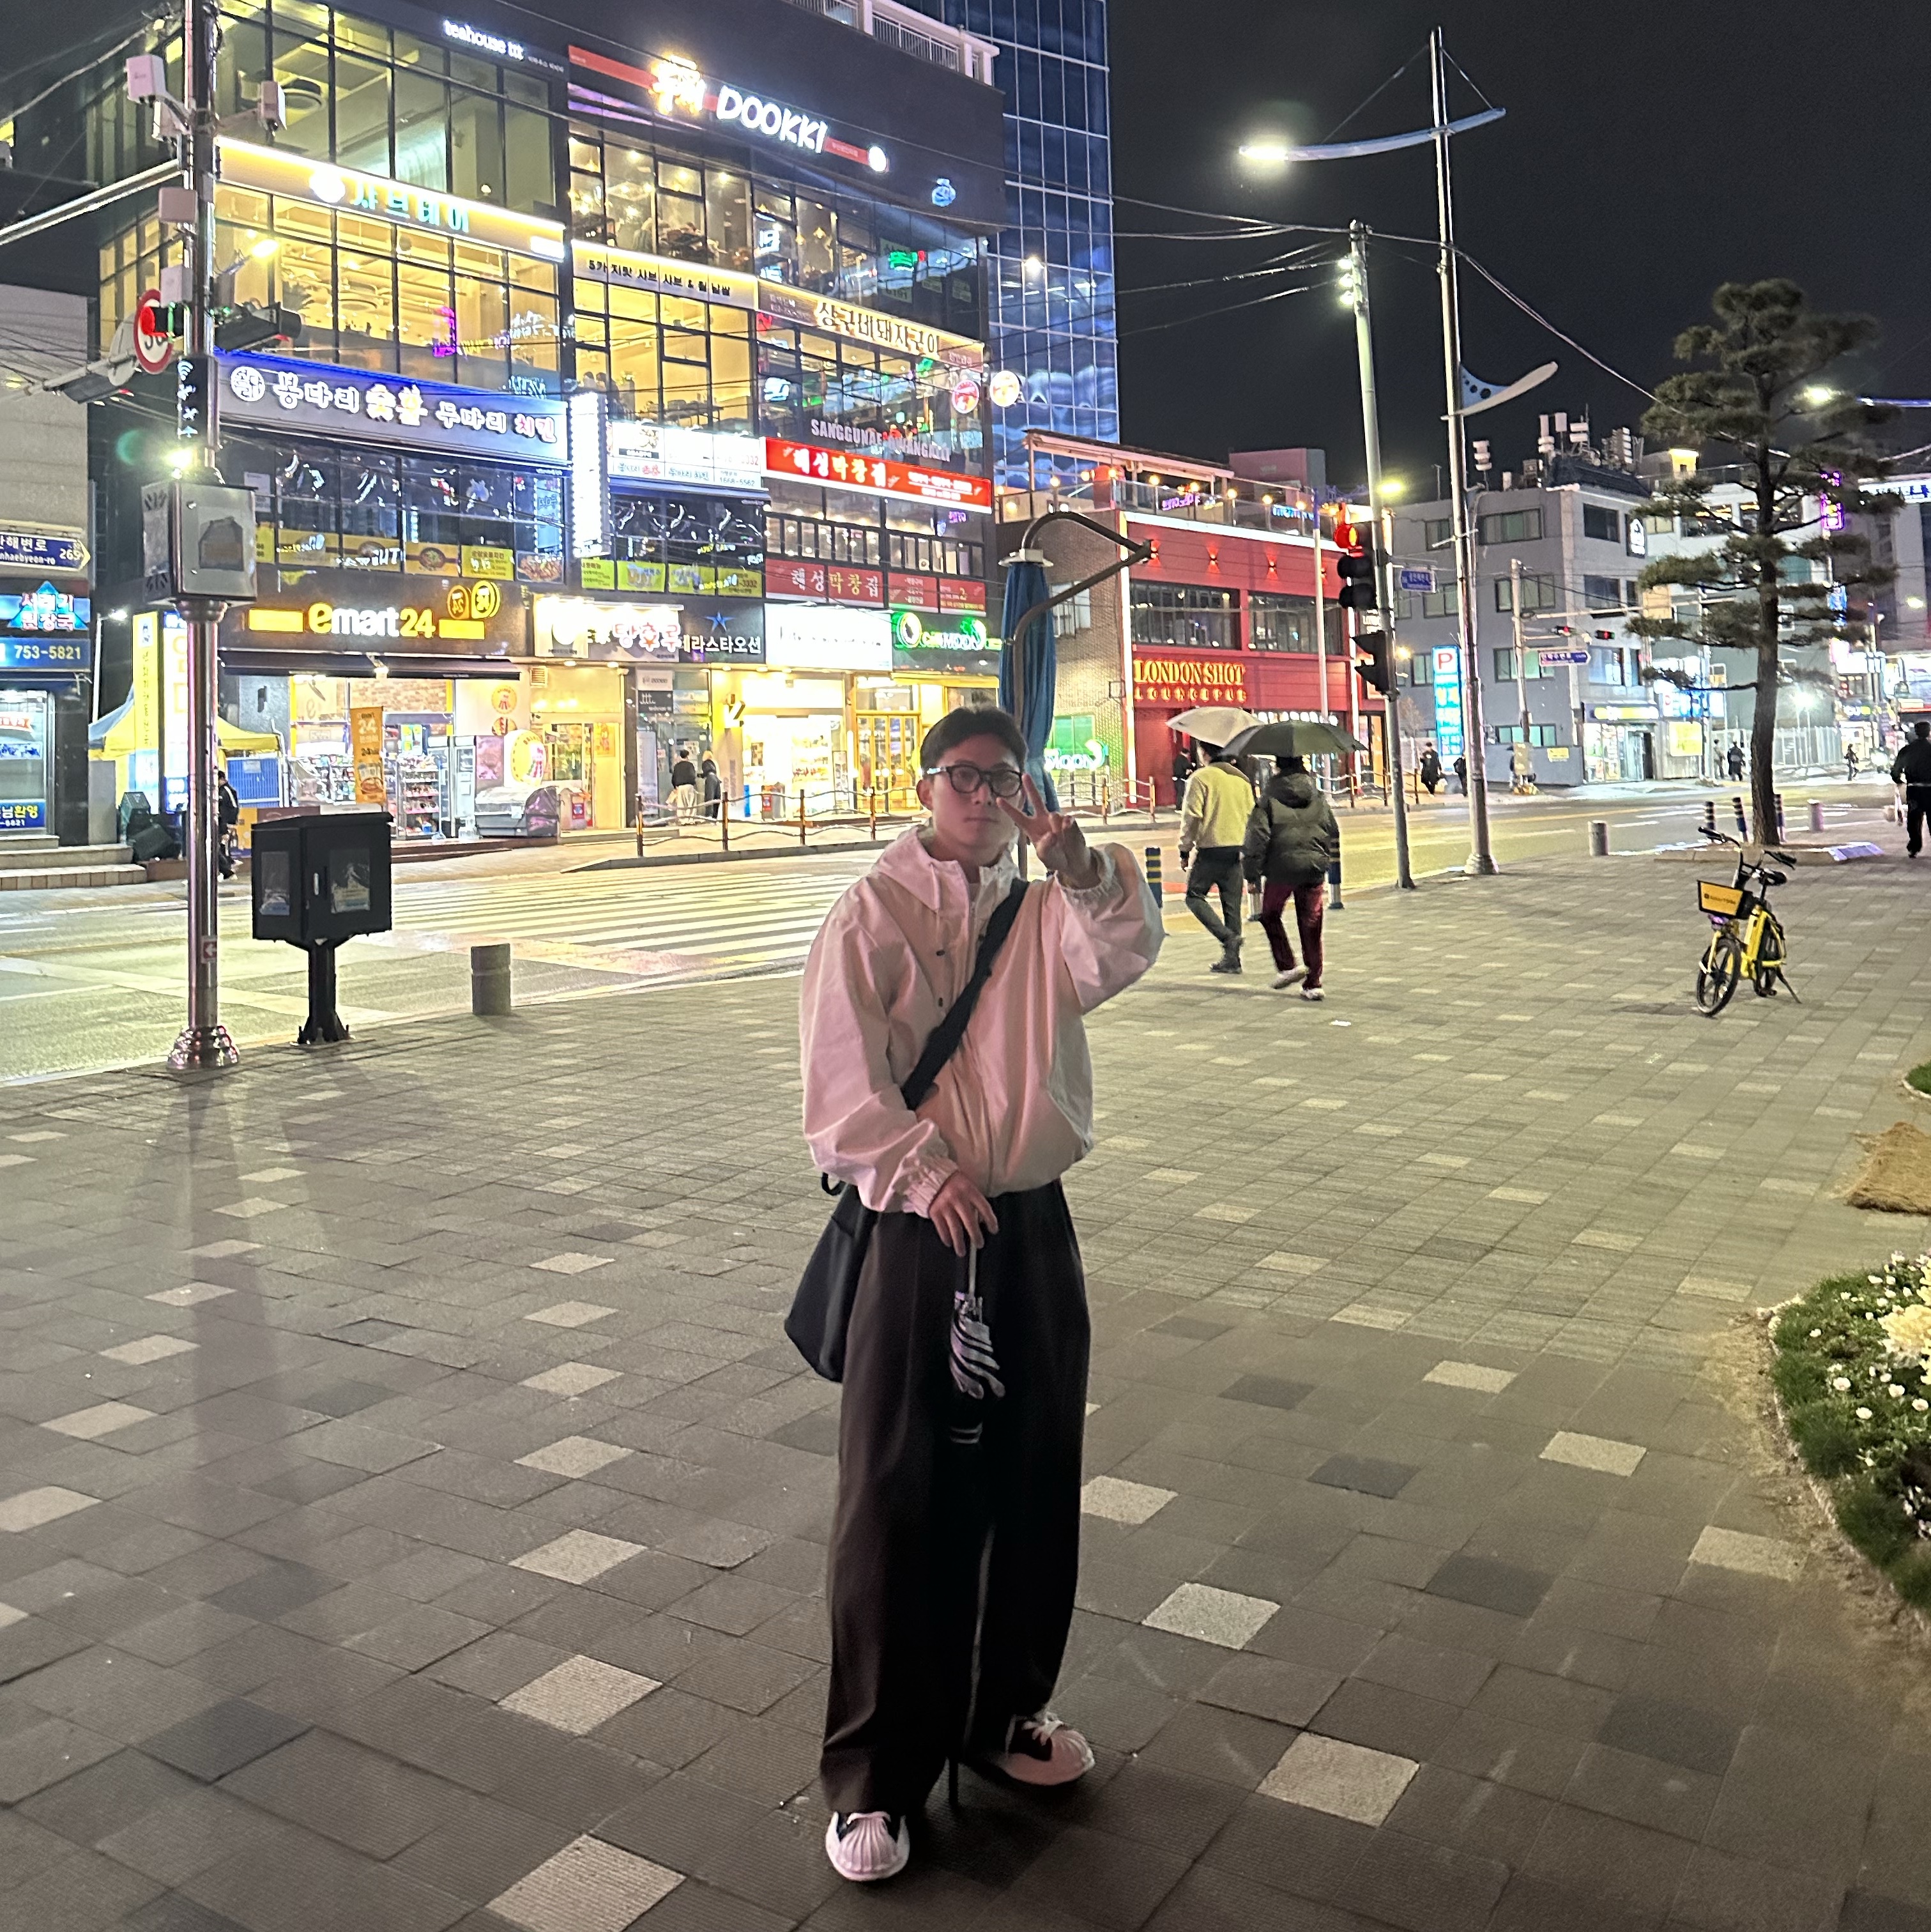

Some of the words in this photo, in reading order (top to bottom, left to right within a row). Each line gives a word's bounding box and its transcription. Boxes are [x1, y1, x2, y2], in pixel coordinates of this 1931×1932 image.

[716, 85, 828, 154] DOOKKI
[436, 401, 508, 434] 두마리
[514, 413, 558, 443] 치킨
[811, 418, 883, 446] SANGGUNAE
[790, 567, 879, 598] 해성막창집
[309, 602, 436, 638] emart24
[13, 644, 81, 660] 753-5821
[1438, 652, 1453, 670] P
[1133, 659, 1202, 686] LONDON
[1203, 662, 1246, 686] SHOT
[0, 804, 39, 819] 님환영
